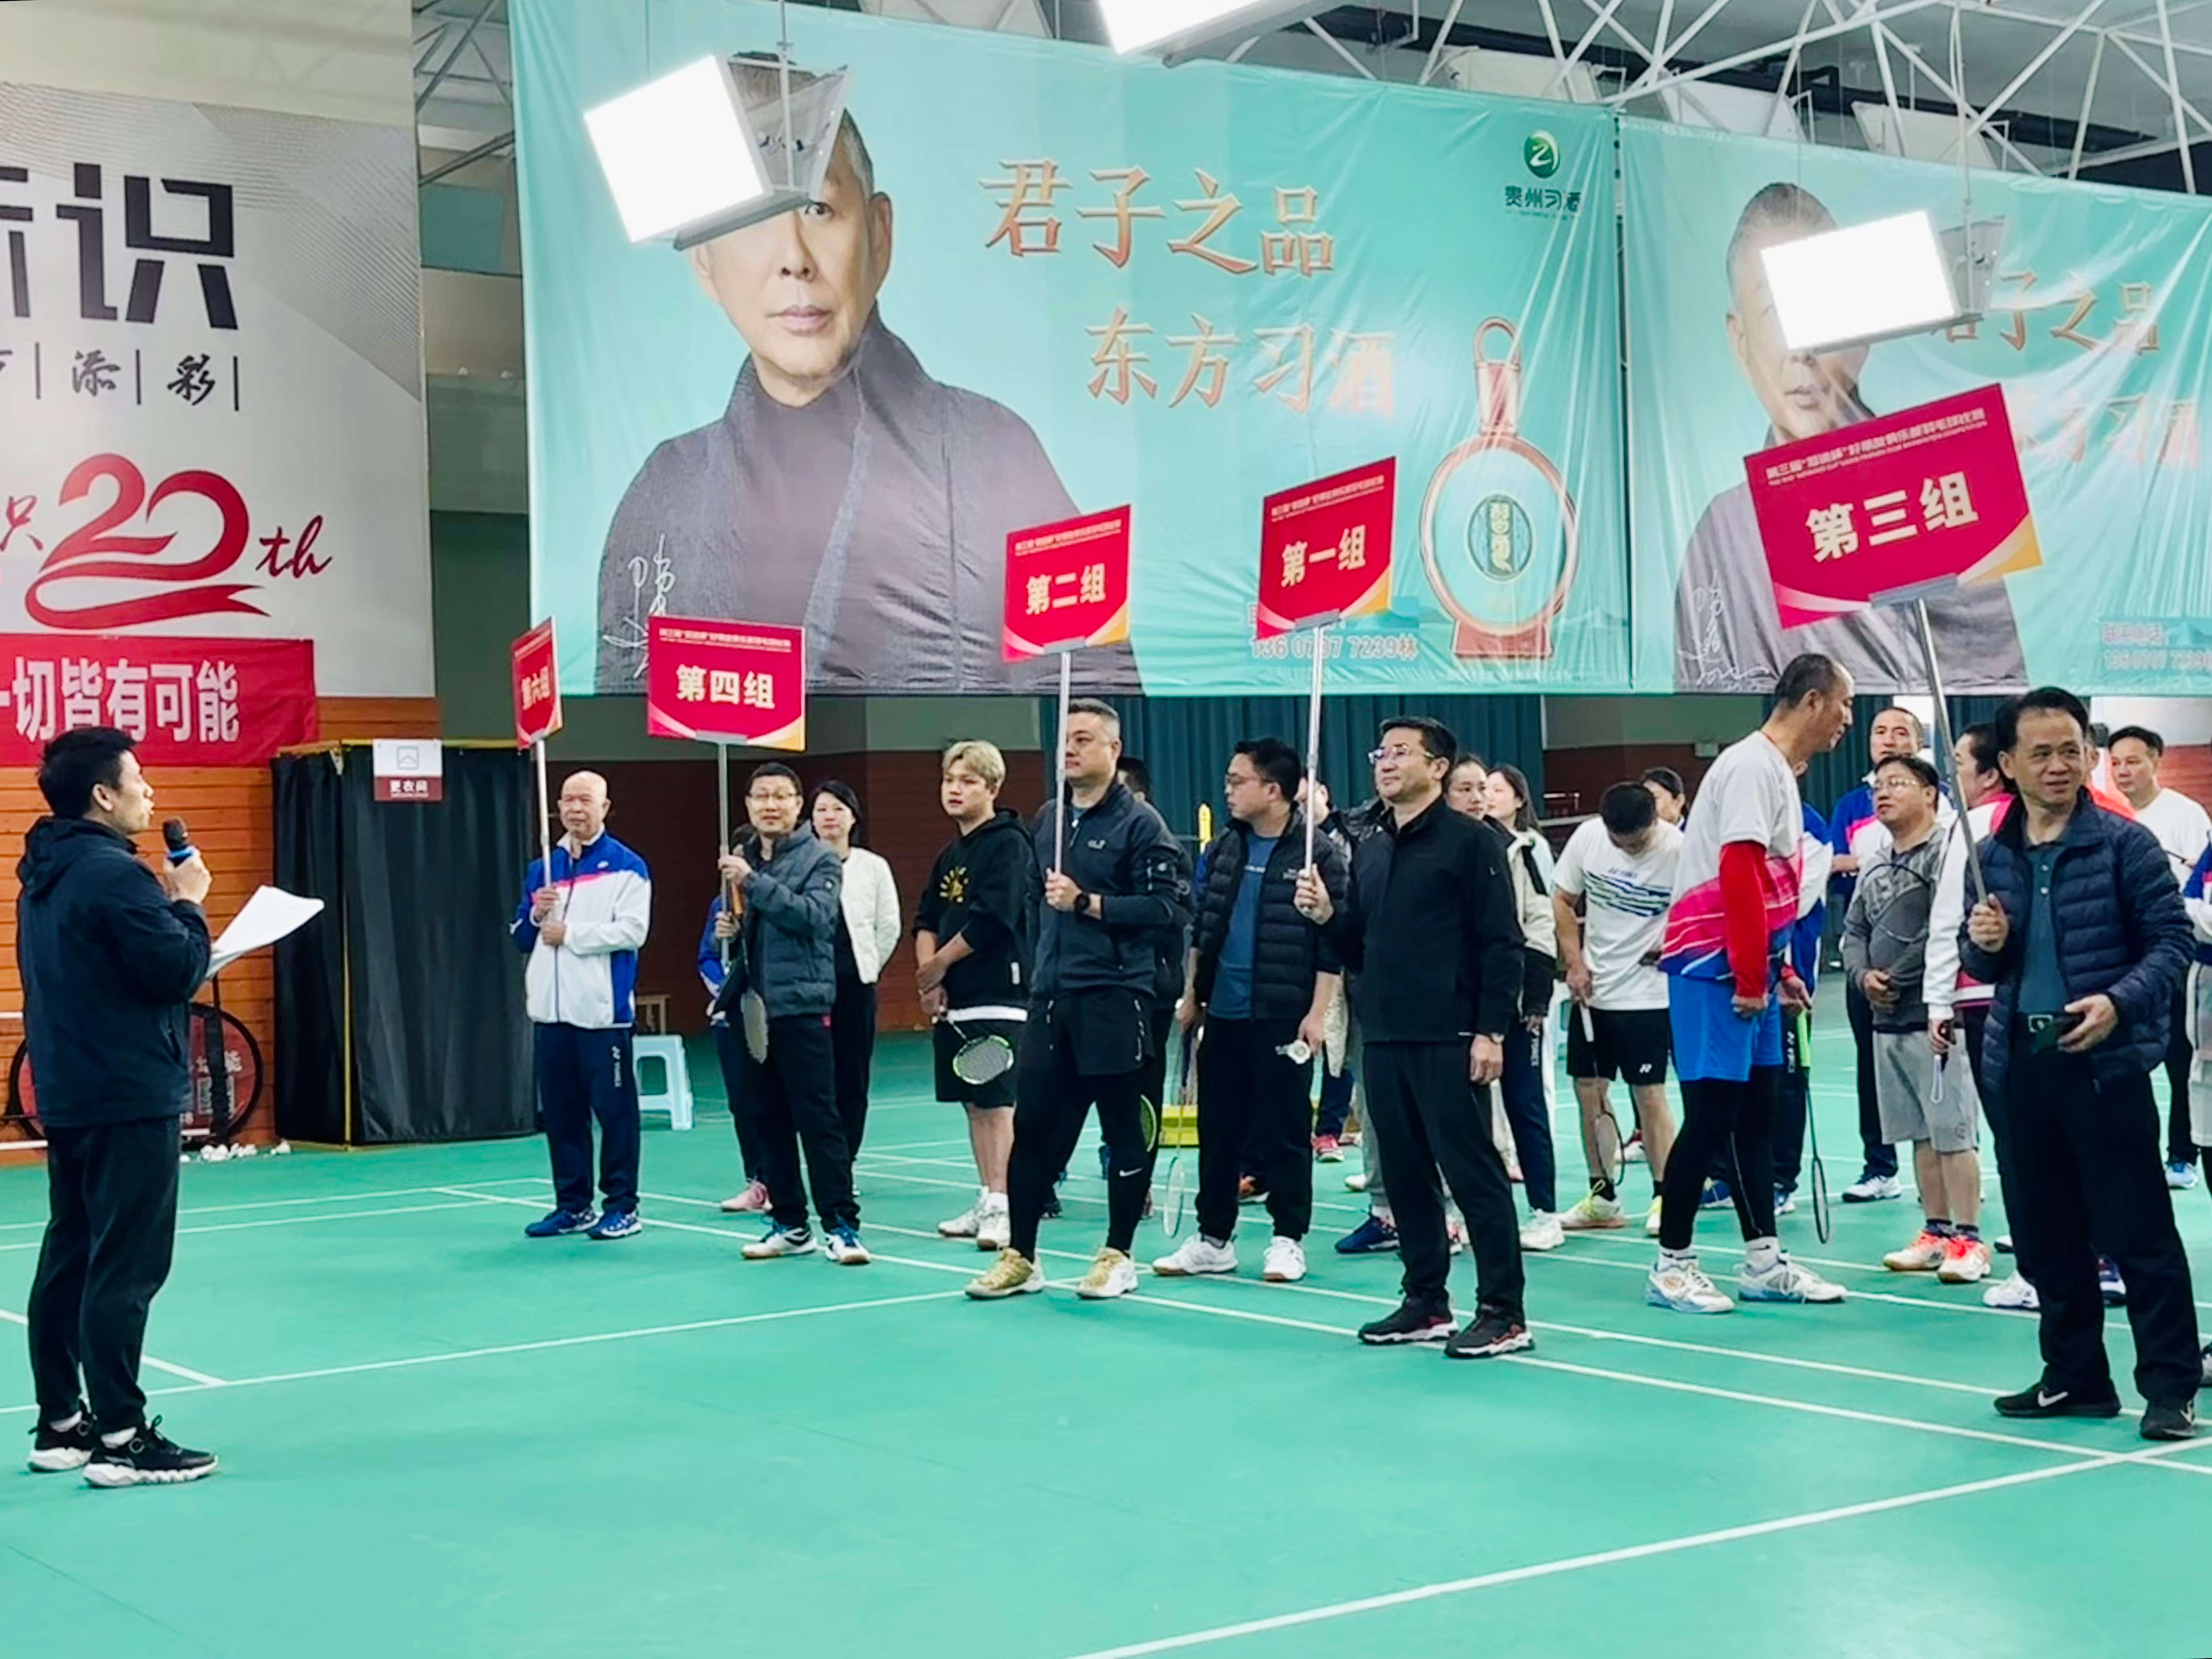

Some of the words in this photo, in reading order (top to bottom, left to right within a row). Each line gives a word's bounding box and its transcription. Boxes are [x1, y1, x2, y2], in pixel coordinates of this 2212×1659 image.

[979, 159, 1334, 277] 君子之品
[1947, 270, 2160, 356] 子之品
[1085, 306, 1398, 415] 东方习酒
[1281, 524, 1366, 588] 第一组
[1805, 471, 1979, 563] 第三组
[1025, 563, 1107, 615] 第二组
[676, 663, 776, 710] 第四组
